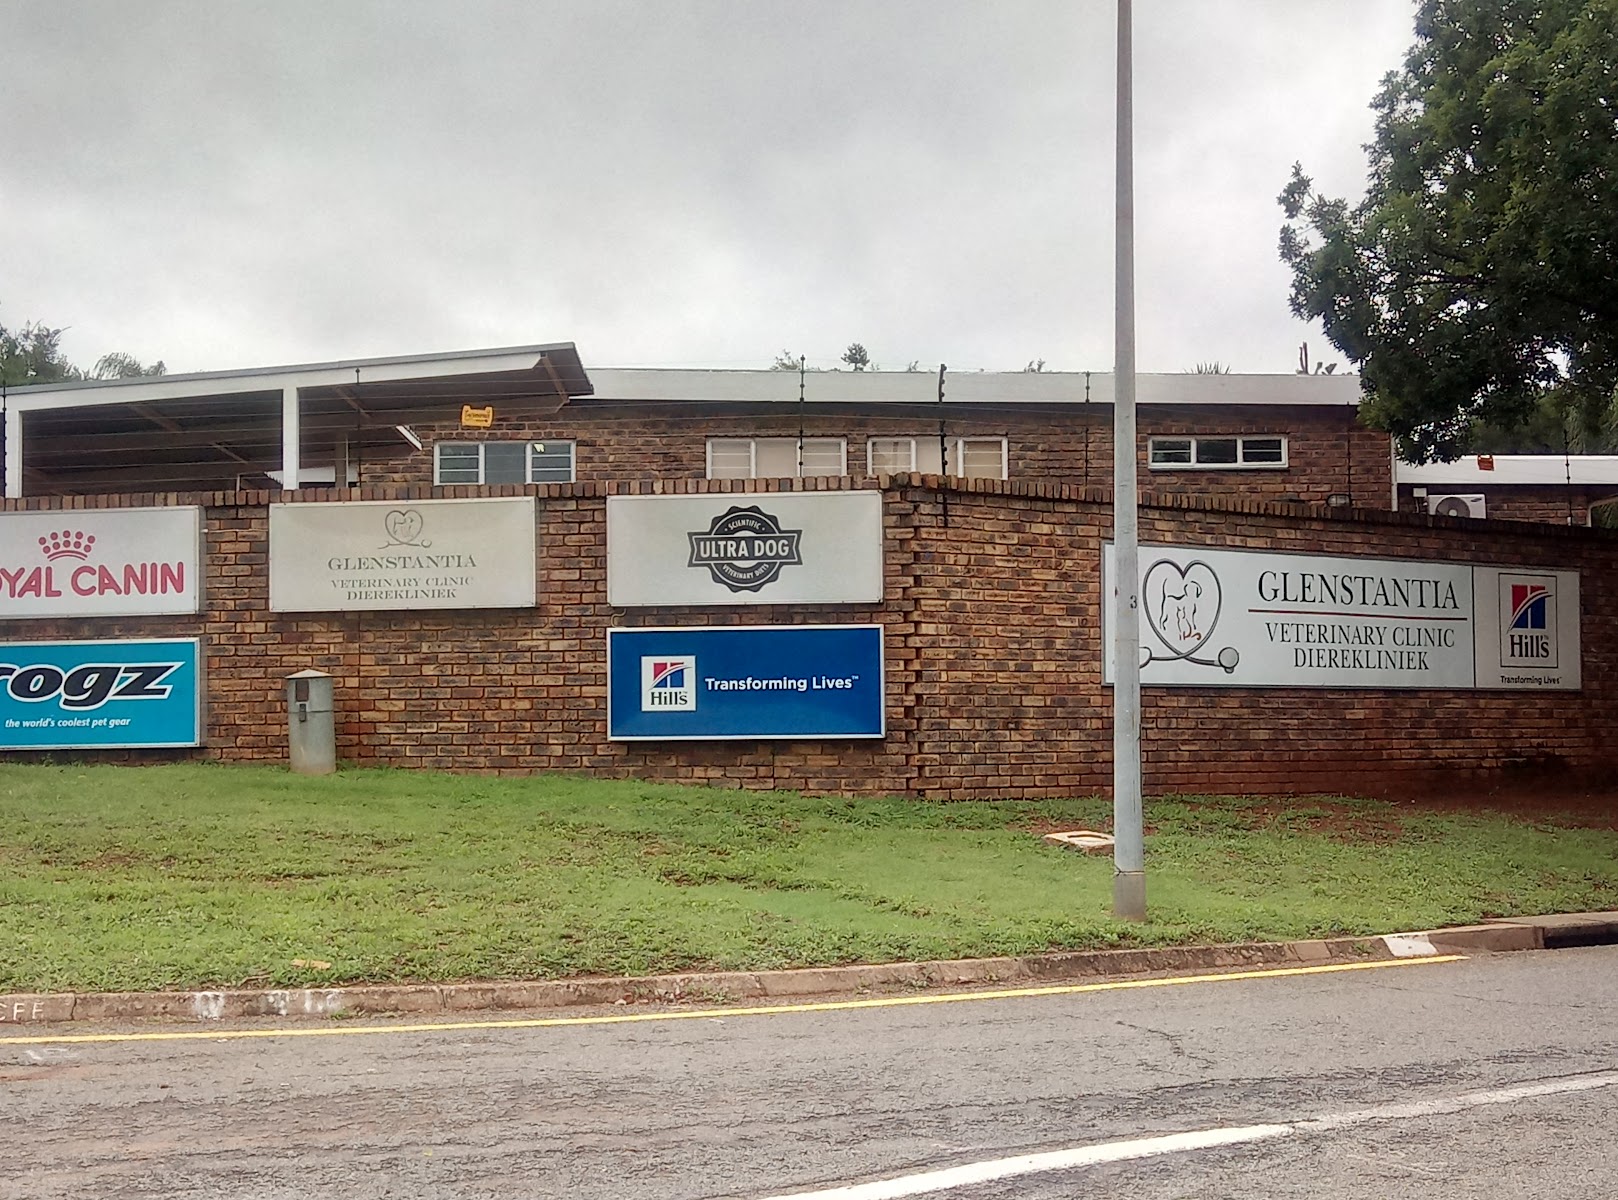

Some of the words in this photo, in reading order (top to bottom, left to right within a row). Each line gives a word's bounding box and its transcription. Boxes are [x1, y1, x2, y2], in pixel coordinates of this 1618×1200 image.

[728, 519, 761, 530] SCIENTIFIC
[700, 540, 749, 558] ULTRA
[754, 539, 789, 557] DOG
[327, 554, 477, 571] GLENSTANTIA
[722, 564, 754, 579] VETERINARY
[754, 563, 770, 577] DIETS
[0, 566, 62, 599] YAL
[70, 561, 185, 597] CANIN
[331, 577, 421, 589] VETERINARY
[425, 576, 474, 587] CLINIC
[347, 588, 456, 600] DIEREKLINIEK
[1258, 570, 1460, 610] GLENSTANTIA
[1265, 622, 1387, 646] VETERINARY
[1392, 626, 1455, 648] CLINIC
[1294, 648, 1429, 670] DIEREKLINIEK
[704, 676, 807, 692] Transforming
[1500, 675, 1542, 685] Transforming
[5, 719, 20, 728] the
[22, 717, 55, 728] world's
[57, 717, 90, 727] coolest
[91, 718, 107, 729] pet
[109, 718, 131, 728] gear
